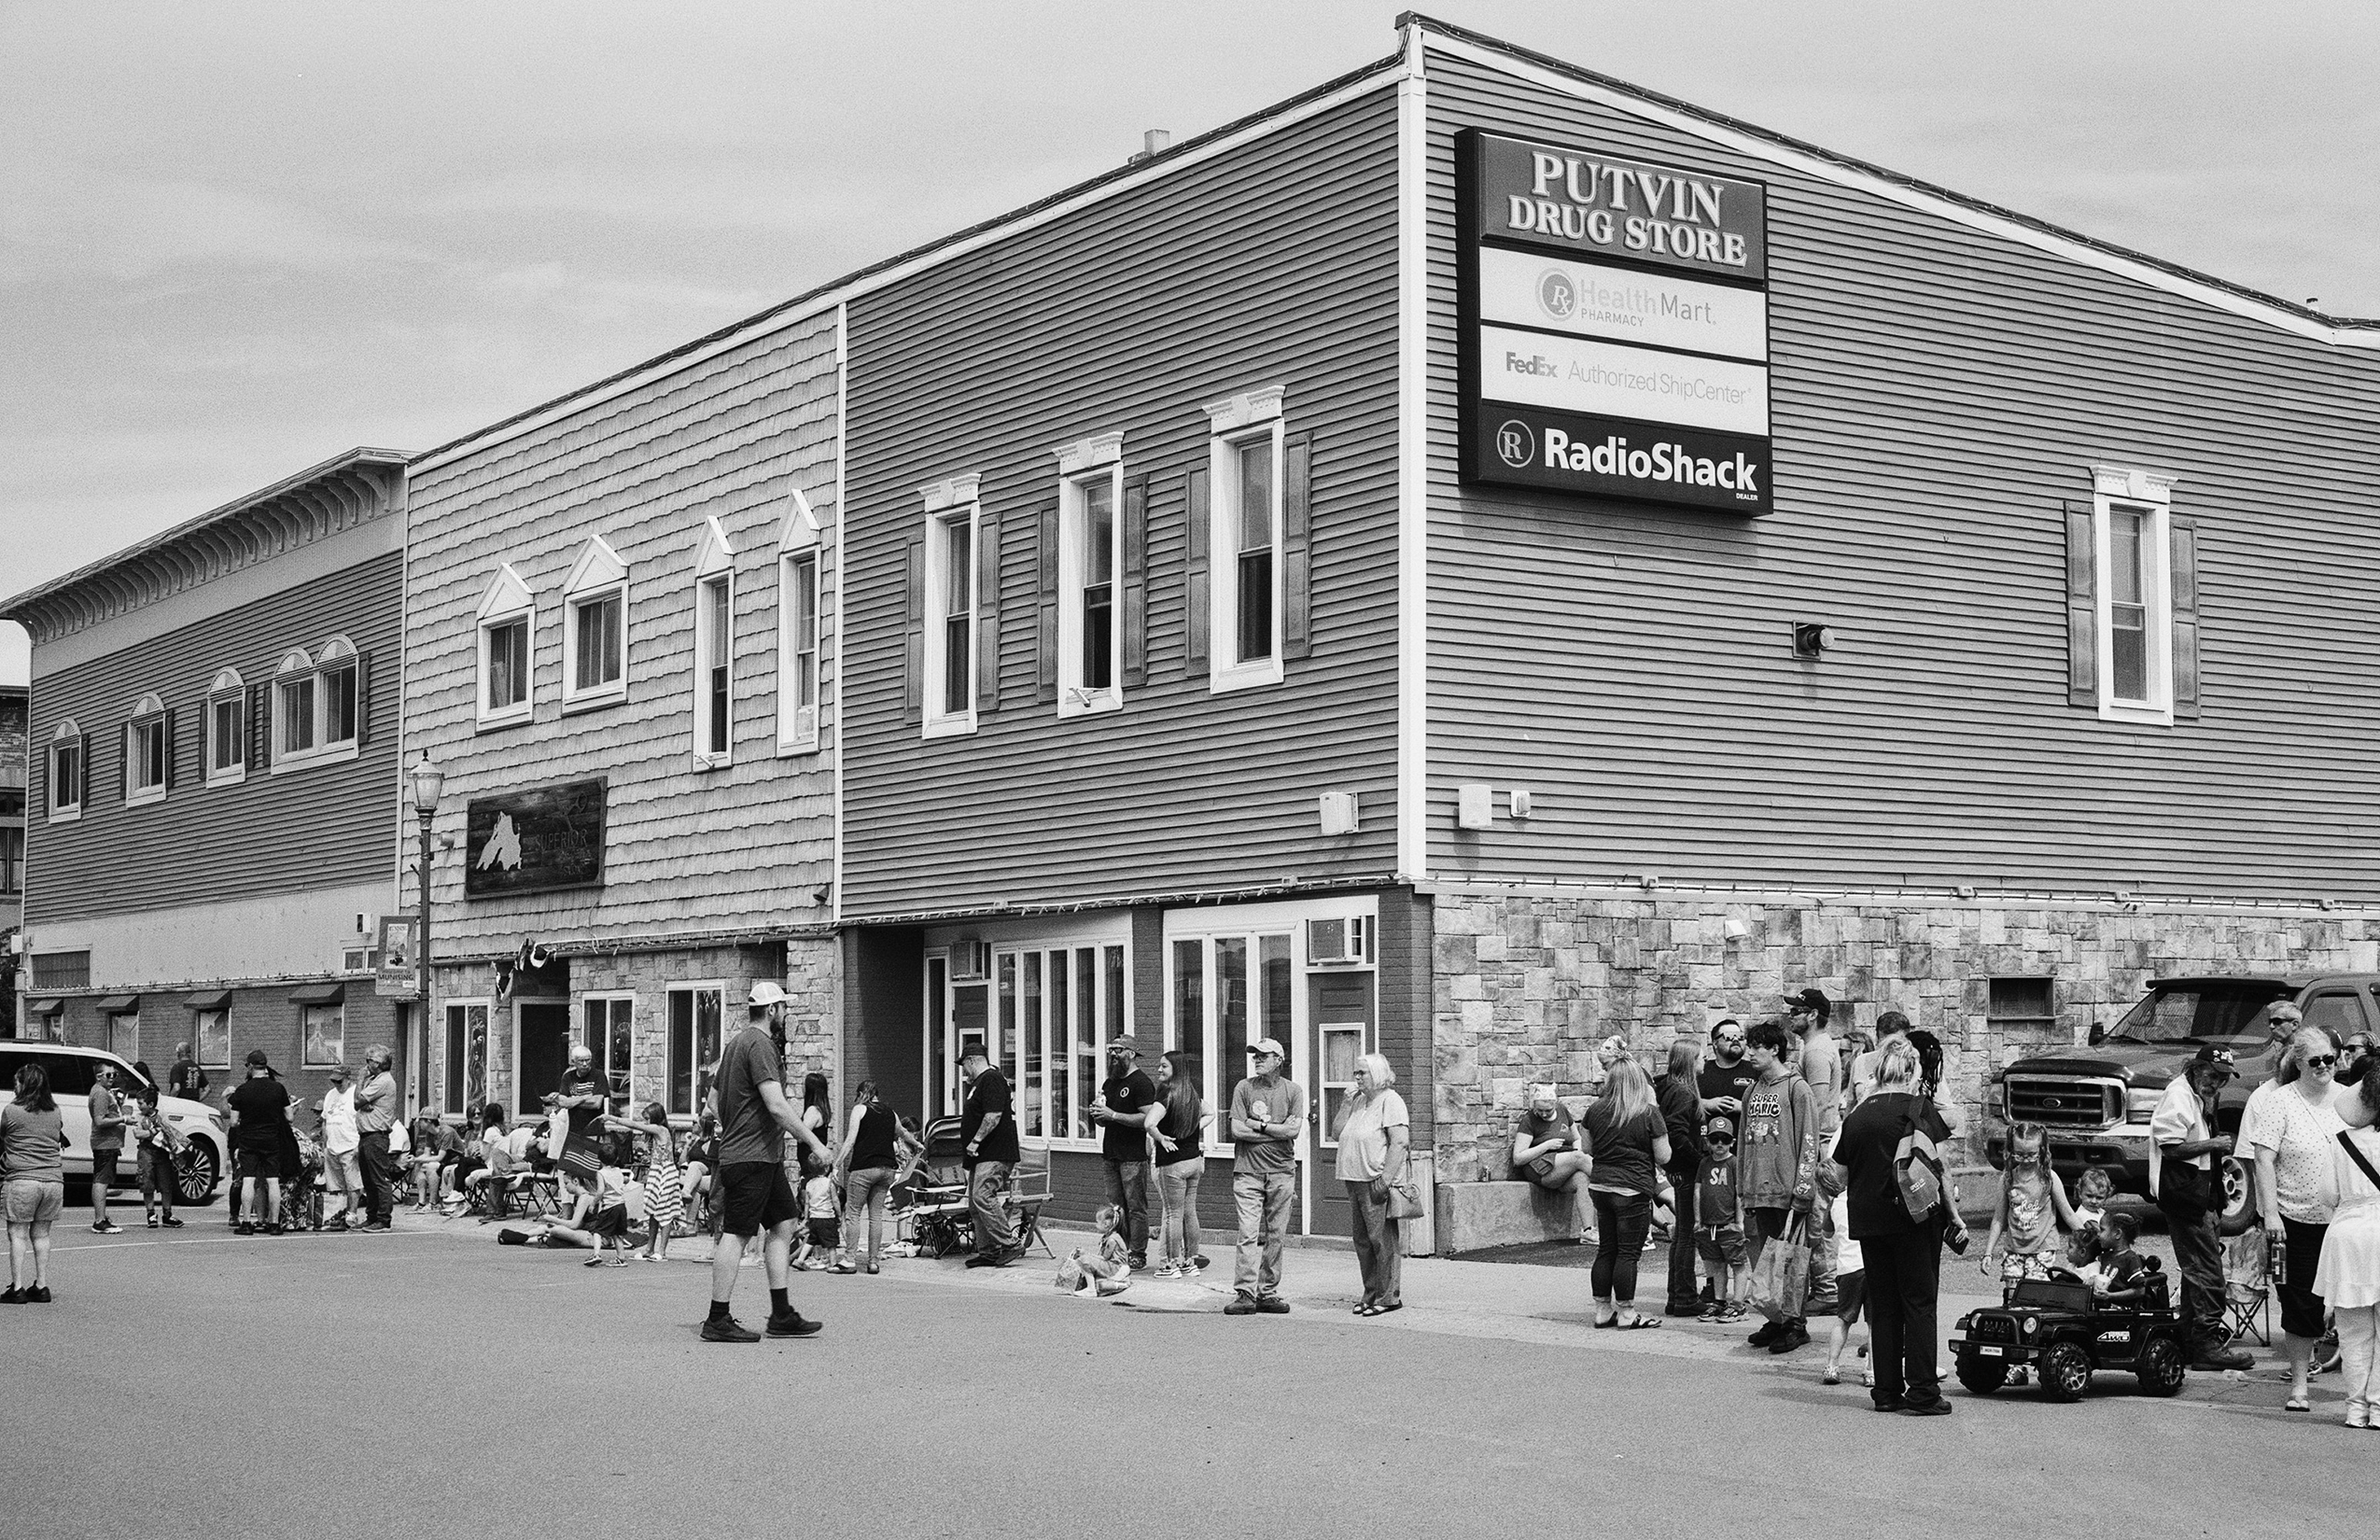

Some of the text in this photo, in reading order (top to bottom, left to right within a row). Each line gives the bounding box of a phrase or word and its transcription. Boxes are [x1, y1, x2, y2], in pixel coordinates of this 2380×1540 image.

[1532, 150, 1725, 228] PUTVIN
[1508, 195, 1748, 268] DRUG STORE
[1581, 308, 1645, 327] PHARMACY
[1505, 350, 1559, 378] FedEx
[1568, 360, 1657, 393] Authorized
[1544, 427, 1757, 492] RadioShack
[1735, 492, 1758, 502] DEALER
[536, 829, 588, 851] SUPERIOR
[1752, 1093, 1780, 1103] SUPER
